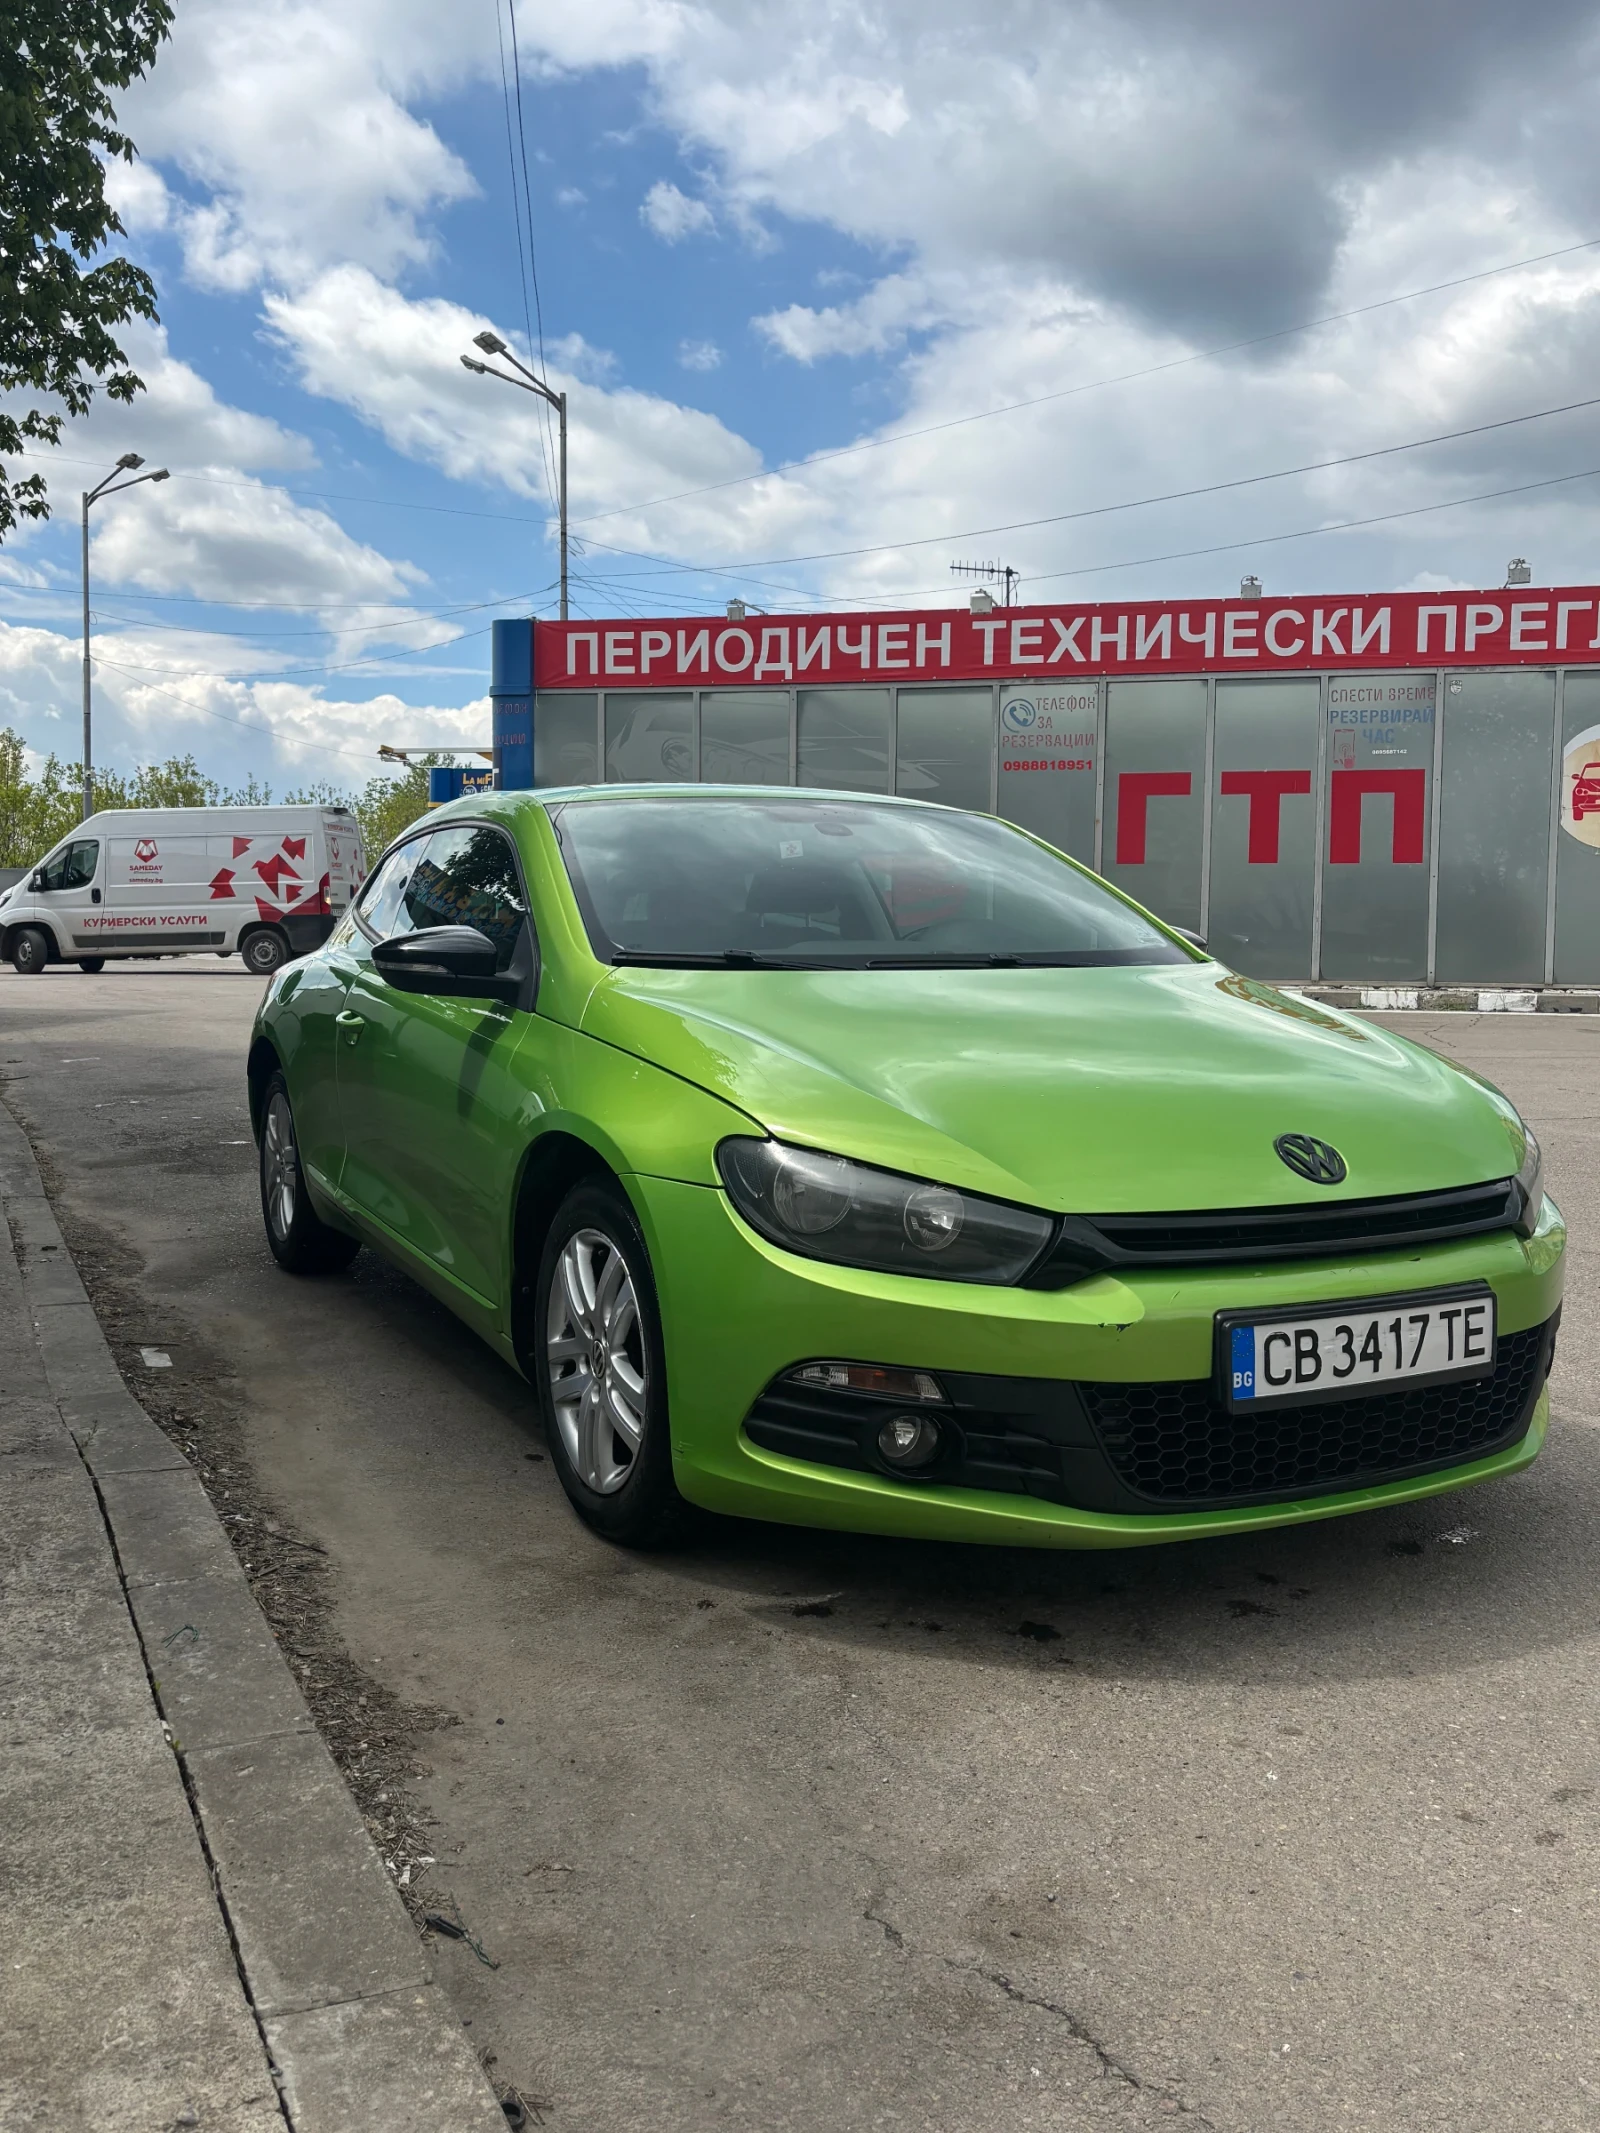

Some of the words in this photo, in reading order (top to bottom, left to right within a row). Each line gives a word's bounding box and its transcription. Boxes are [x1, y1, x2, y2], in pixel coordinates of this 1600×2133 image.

[566, 622, 952, 680] ПЕРИОДИЧЕН
[971, 607, 1391, 665] ТЕХНИЧЕСКИ
[1331, 688, 1383, 702] СПЕСТИ
[1388, 686, 1435, 701] ВРЕМЕ
[1035, 695, 1095, 712] ТЕЛЕФОН
[1037, 716, 1053, 729] ЗА
[1330, 705, 1435, 724] РЕЗЕРВИРАЙ
[1002, 733, 1095, 748] РЕЗЕРВАЦИИ
[1361, 728, 1395, 744] ЧАС
[1003, 760, 1093, 771] 0988818951
[1116, 769, 1426, 865] ГТП
[83, 916, 157, 927] КУРИЕРСКИ
[159, 915, 208, 925] УСЛУГИ
[1263, 1329, 1322, 1386] CB
[1333, 1314, 1430, 1378] 3417
[1439, 1305, 1486, 1362] TE
[1233, 1371, 1253, 1388] BG
